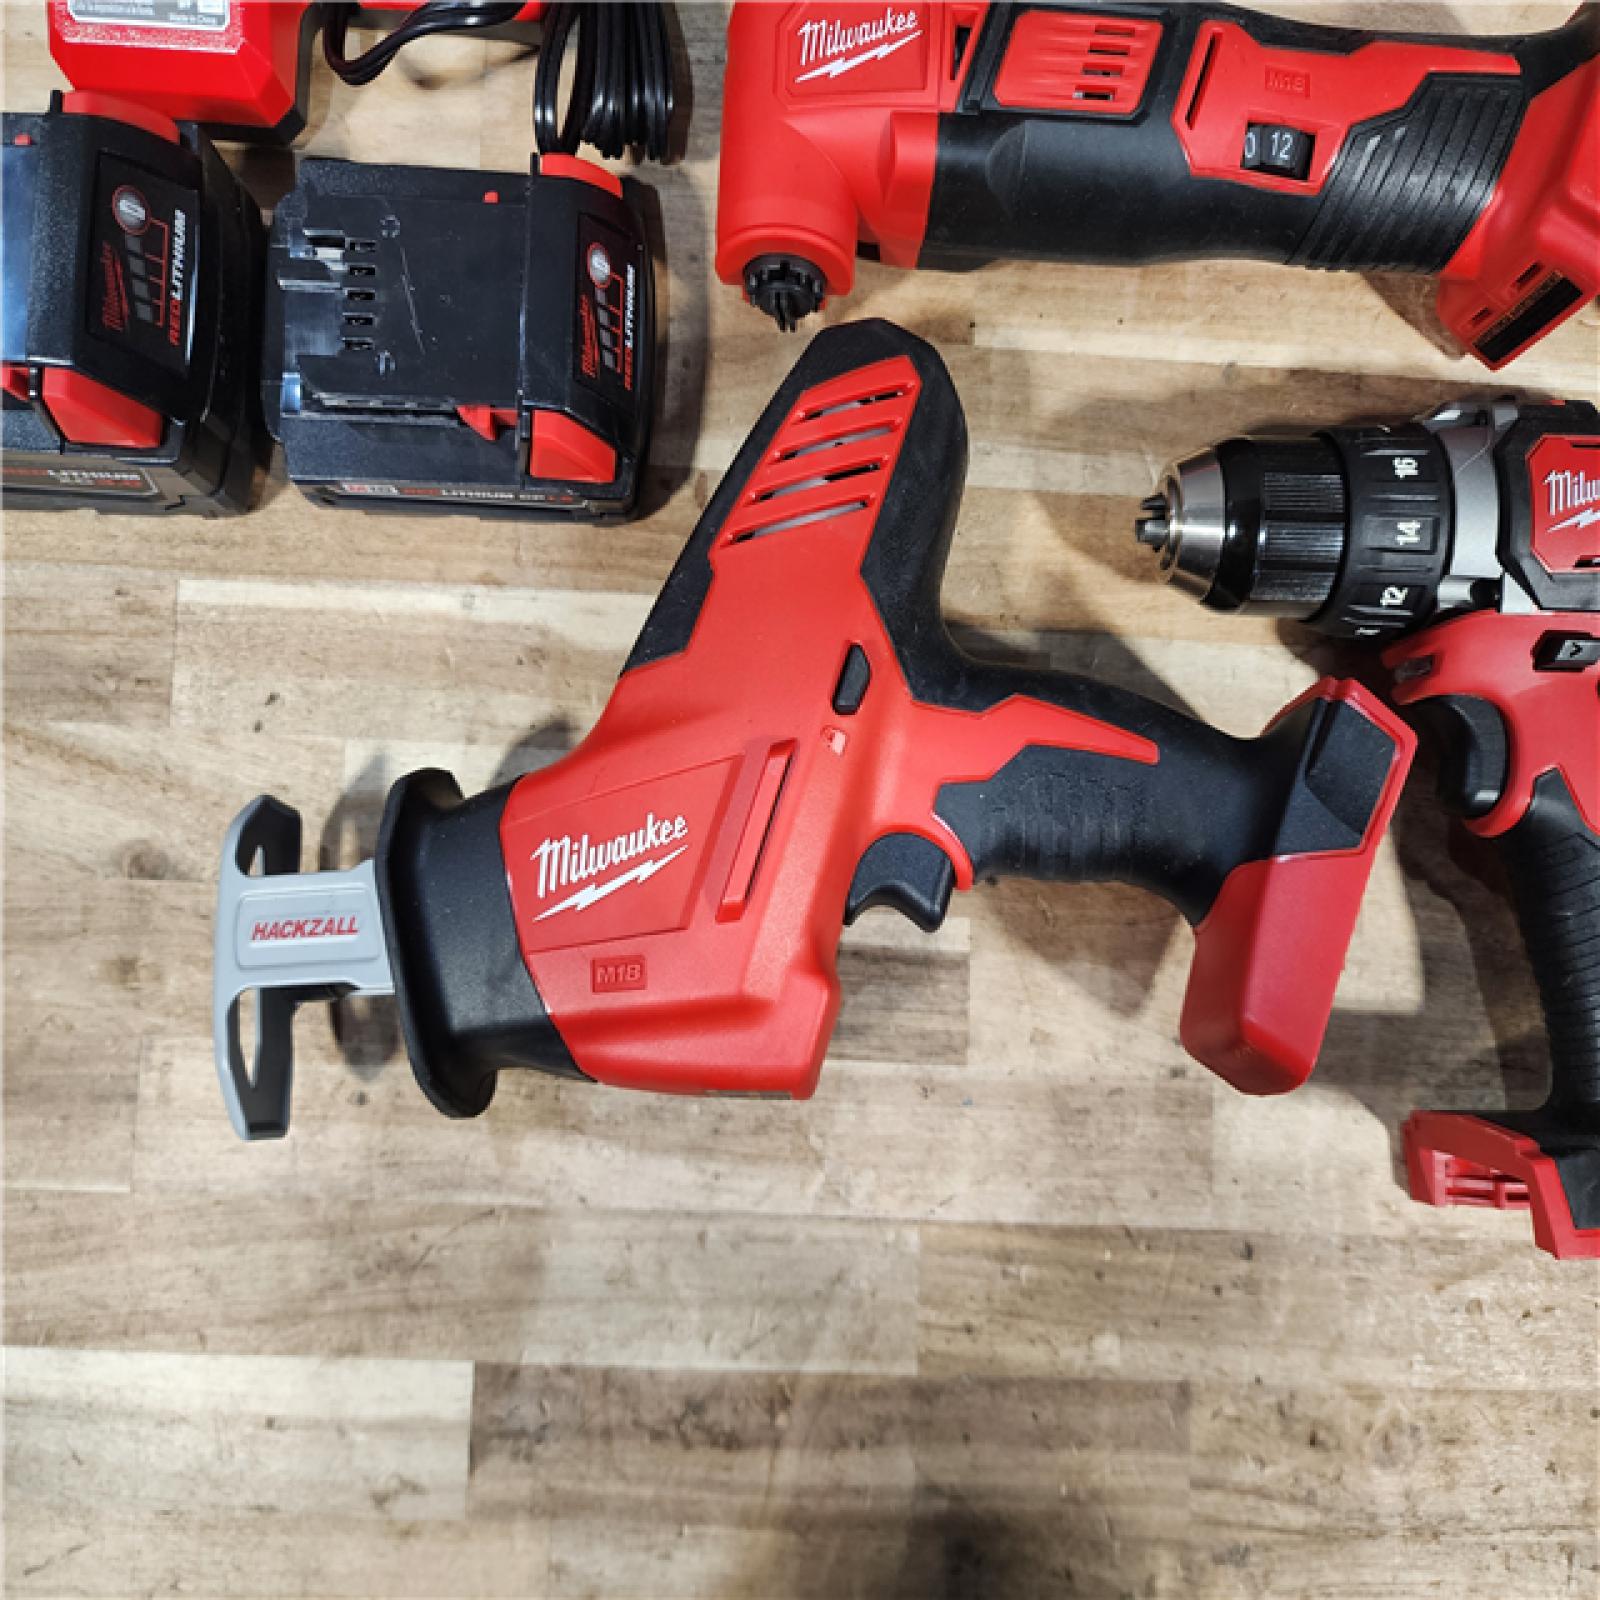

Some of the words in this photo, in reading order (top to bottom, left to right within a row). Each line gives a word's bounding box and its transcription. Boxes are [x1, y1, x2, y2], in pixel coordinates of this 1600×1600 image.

[797, 7, 917, 66] Milwaukee
[1271, 131, 1293, 160] 12
[1392, 457, 1418, 478] 16
[1395, 519, 1421, 545] 14
[1380, 585, 1409, 607] 12
[530, 811, 688, 899] Milwaukee
[251, 914, 360, 941] HACKZALL
[596, 963, 641, 984] M18
